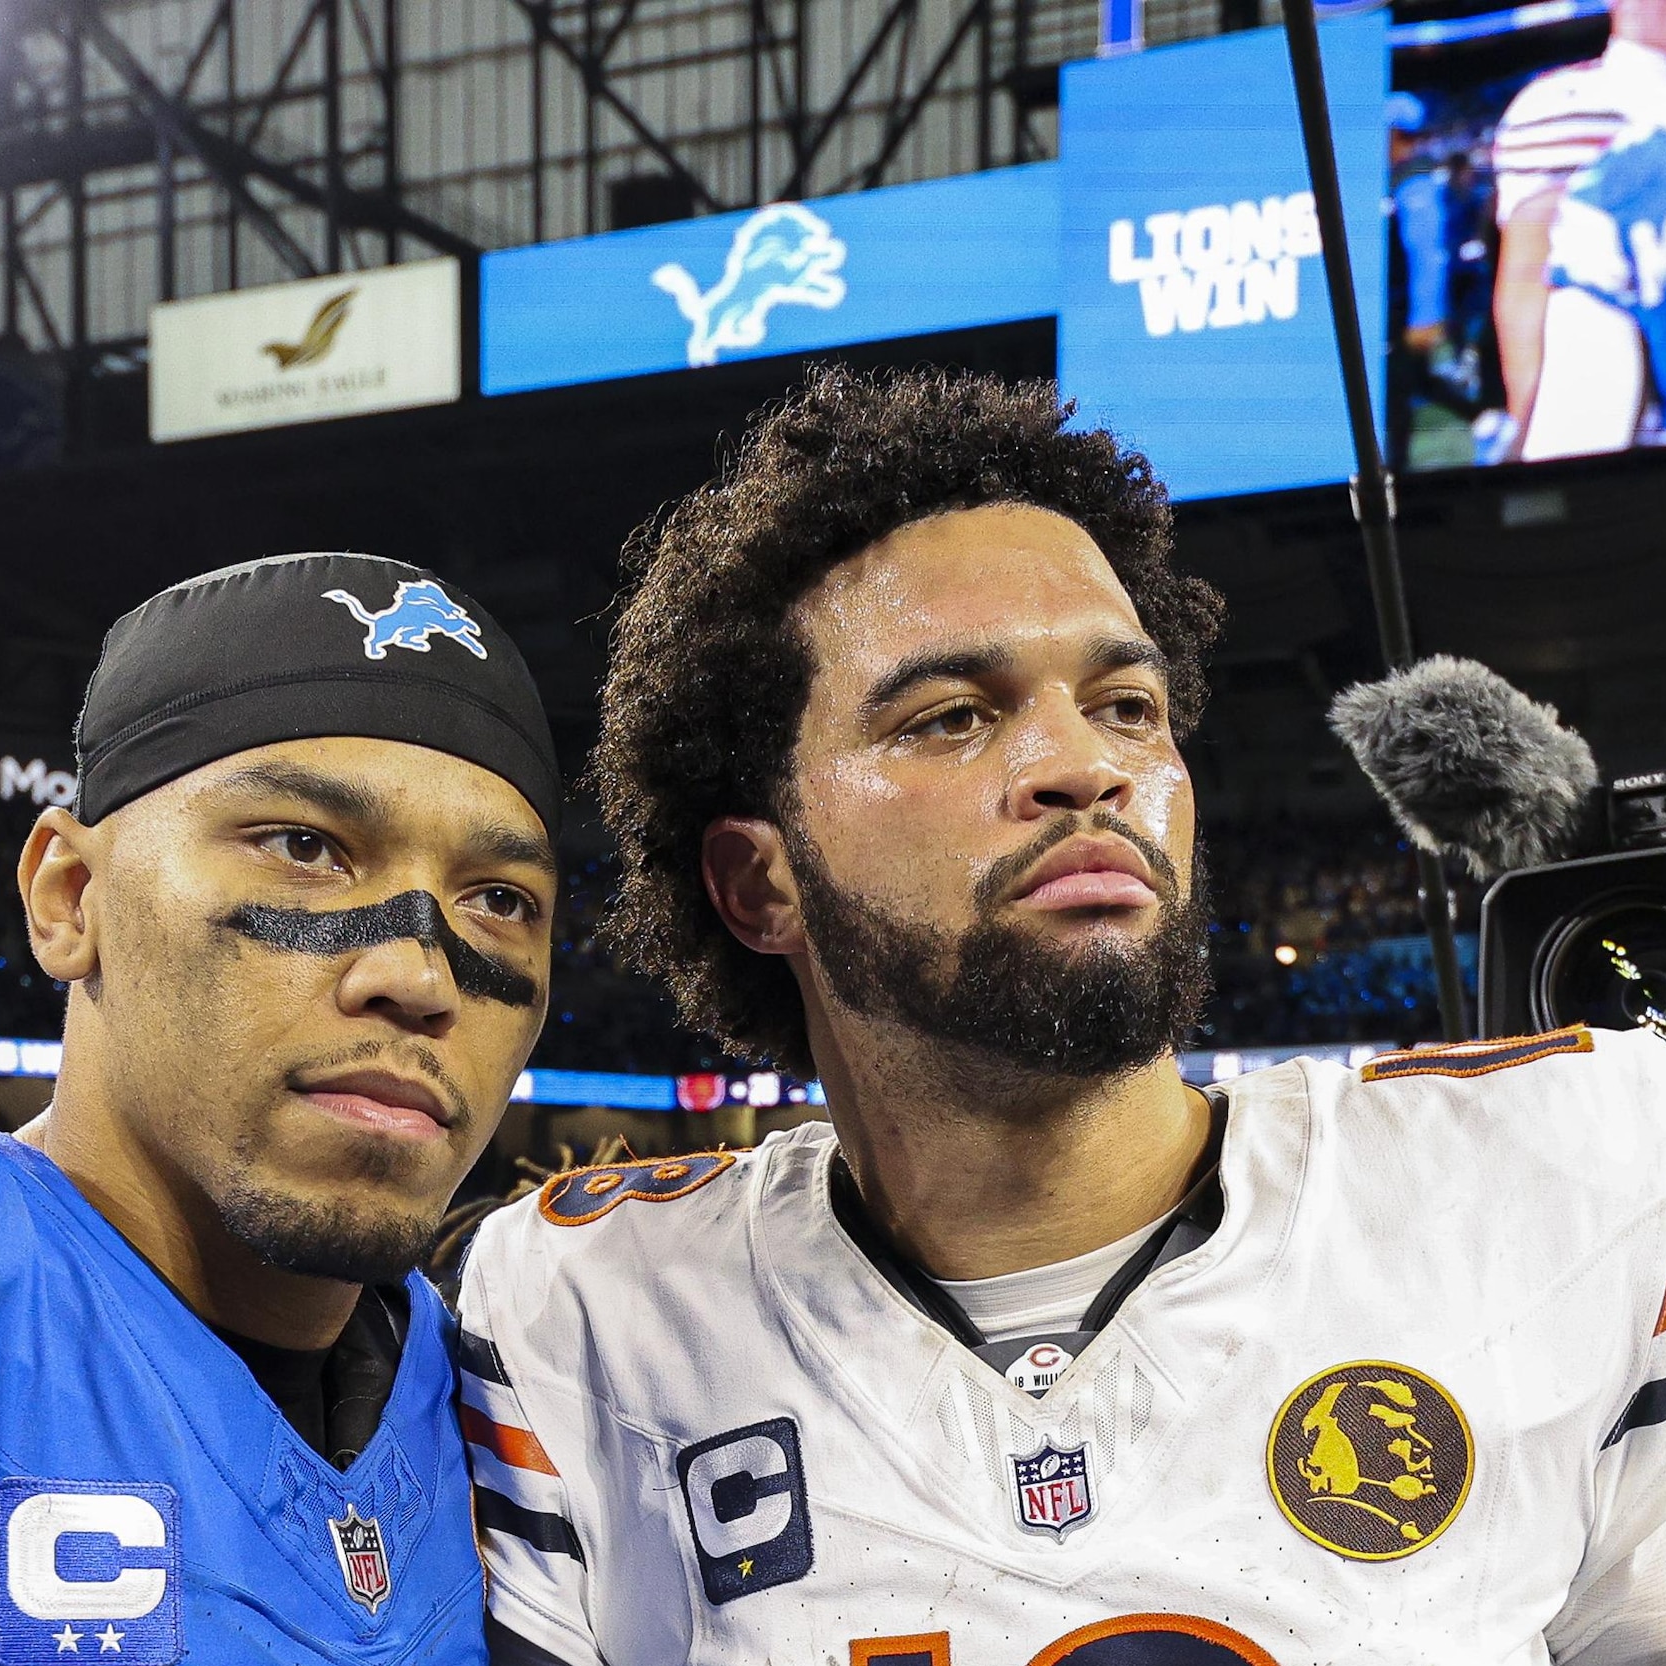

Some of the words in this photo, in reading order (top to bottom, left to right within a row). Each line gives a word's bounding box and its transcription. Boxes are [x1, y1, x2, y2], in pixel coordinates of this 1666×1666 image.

[1109, 191, 1322, 284] LIONS
[1139, 256, 1299, 337] WIN
[1612, 772, 1666, 792] SONY
[1014, 1376, 1024, 1388] 18
[1033, 1371, 1063, 1387] WILLI
[687, 1435, 793, 1559] C
[1025, 1480, 1085, 1522] NFL
[7, 1493, 167, 1621] C
[349, 1554, 385, 1594] NFL
